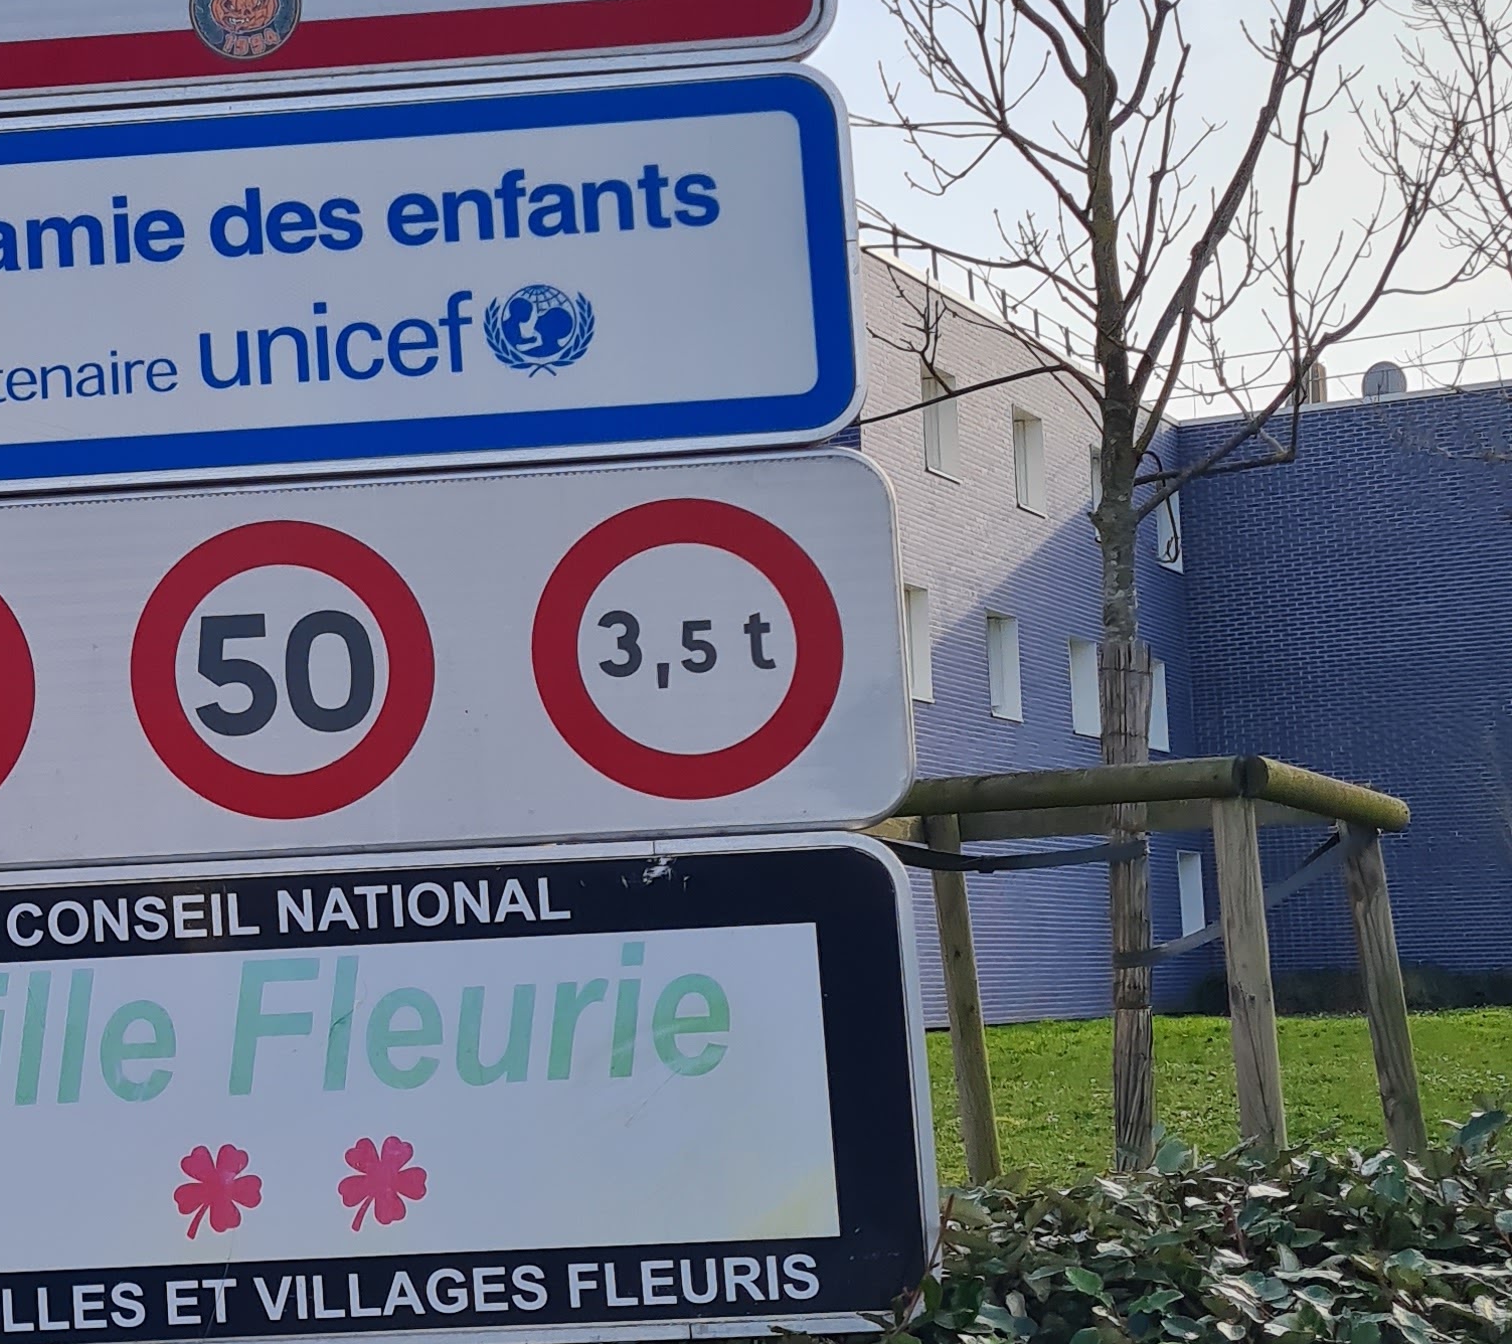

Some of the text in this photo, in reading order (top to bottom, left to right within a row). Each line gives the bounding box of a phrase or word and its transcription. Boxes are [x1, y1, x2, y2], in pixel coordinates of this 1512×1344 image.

[210, 187, 363, 257] des
[387, 165, 720, 246] enfants
[200, 291, 472, 389] unicef
[196, 610, 374, 736] 50
[7, 878, 570, 946] CONSEIL NATIONAL
[230, 945, 729, 1094] Fleurie
[166, 1279, 236, 1325] ET
[253, 1265, 547, 1320] VILLAGES
[568, 1254, 819, 1308] FLEURIS
